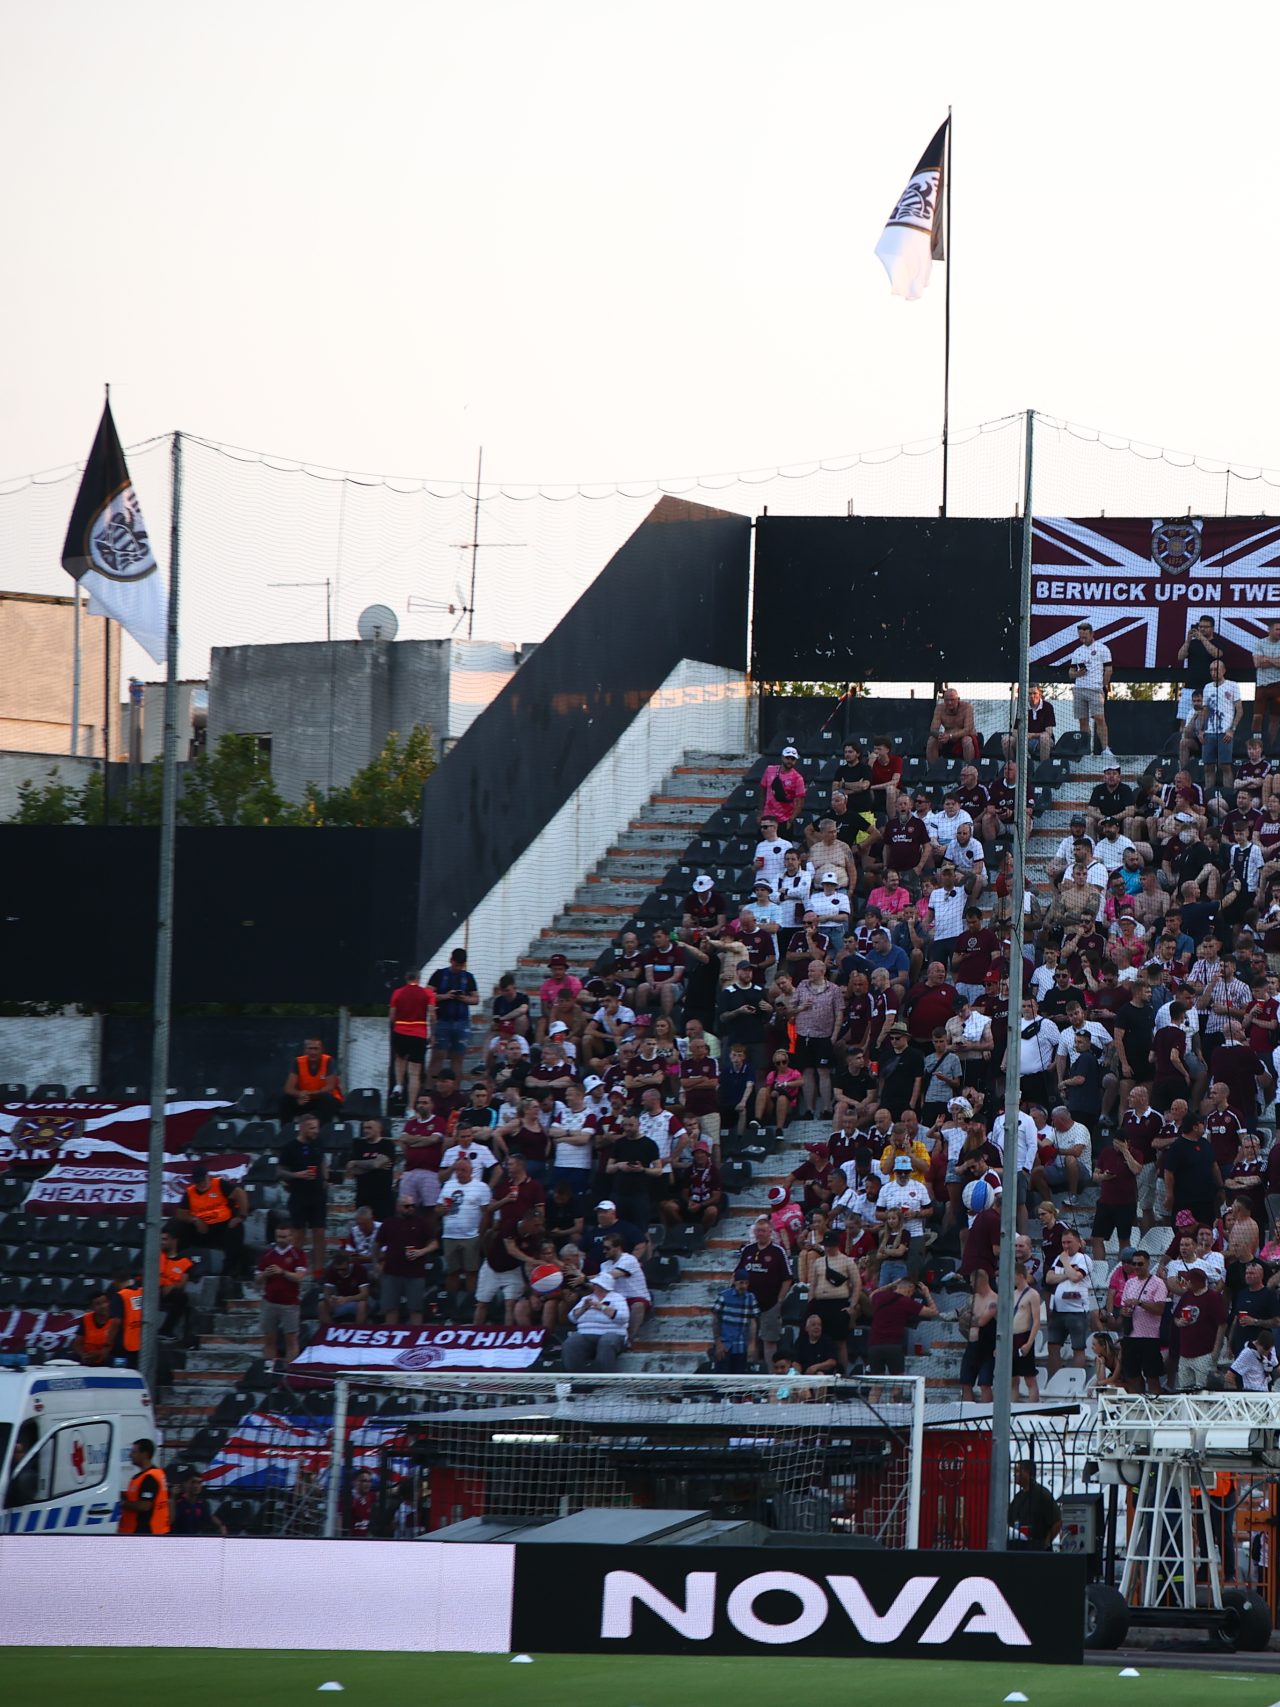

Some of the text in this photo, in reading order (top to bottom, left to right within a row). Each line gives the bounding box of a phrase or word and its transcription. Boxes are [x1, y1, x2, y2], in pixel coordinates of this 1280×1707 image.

[1035, 581, 1147, 600] BERWICK
[1154, 583, 1222, 601] UPON
[38, 1187, 135, 1202] HEARTS
[325, 1327, 546, 1347] WEST LOTHIAN
[601, 1570, 1033, 1646] NOVA
